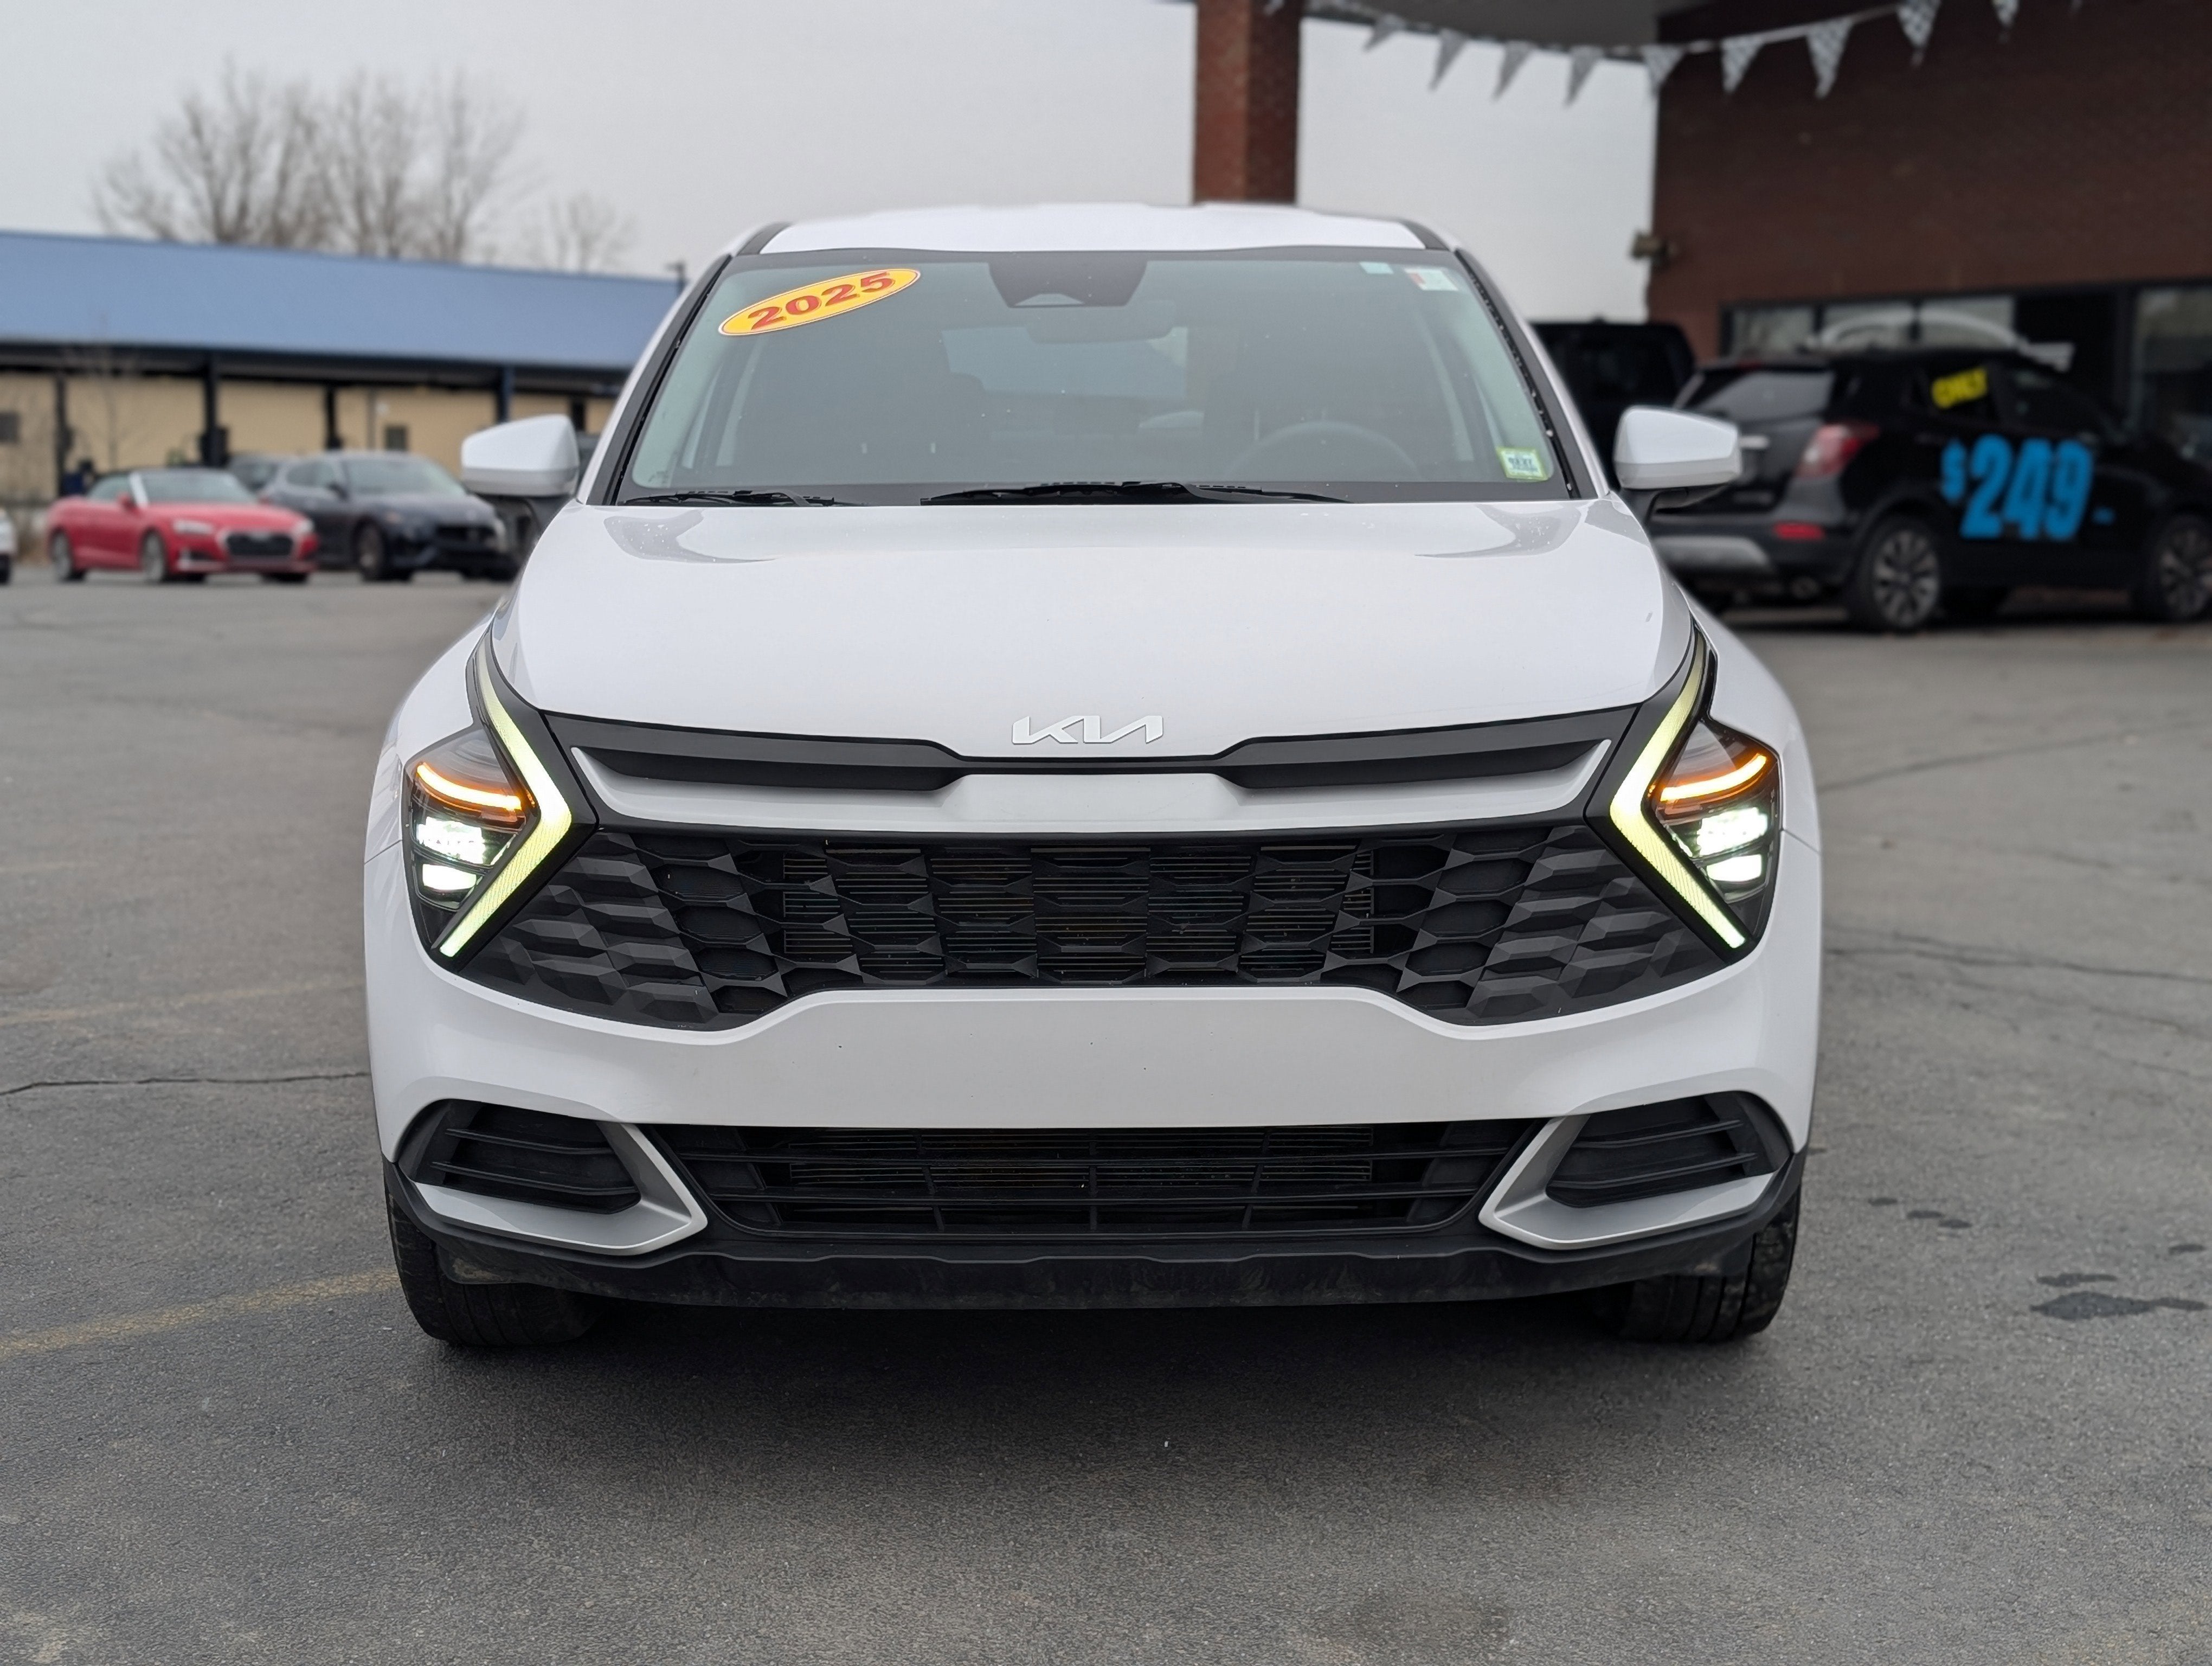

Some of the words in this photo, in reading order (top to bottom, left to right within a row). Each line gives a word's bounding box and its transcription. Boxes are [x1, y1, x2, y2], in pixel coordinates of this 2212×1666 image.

[748, 272, 896, 330] 2025
[1940, 434, 2093, 539] $249
[1012, 715, 1163, 745] KIA
